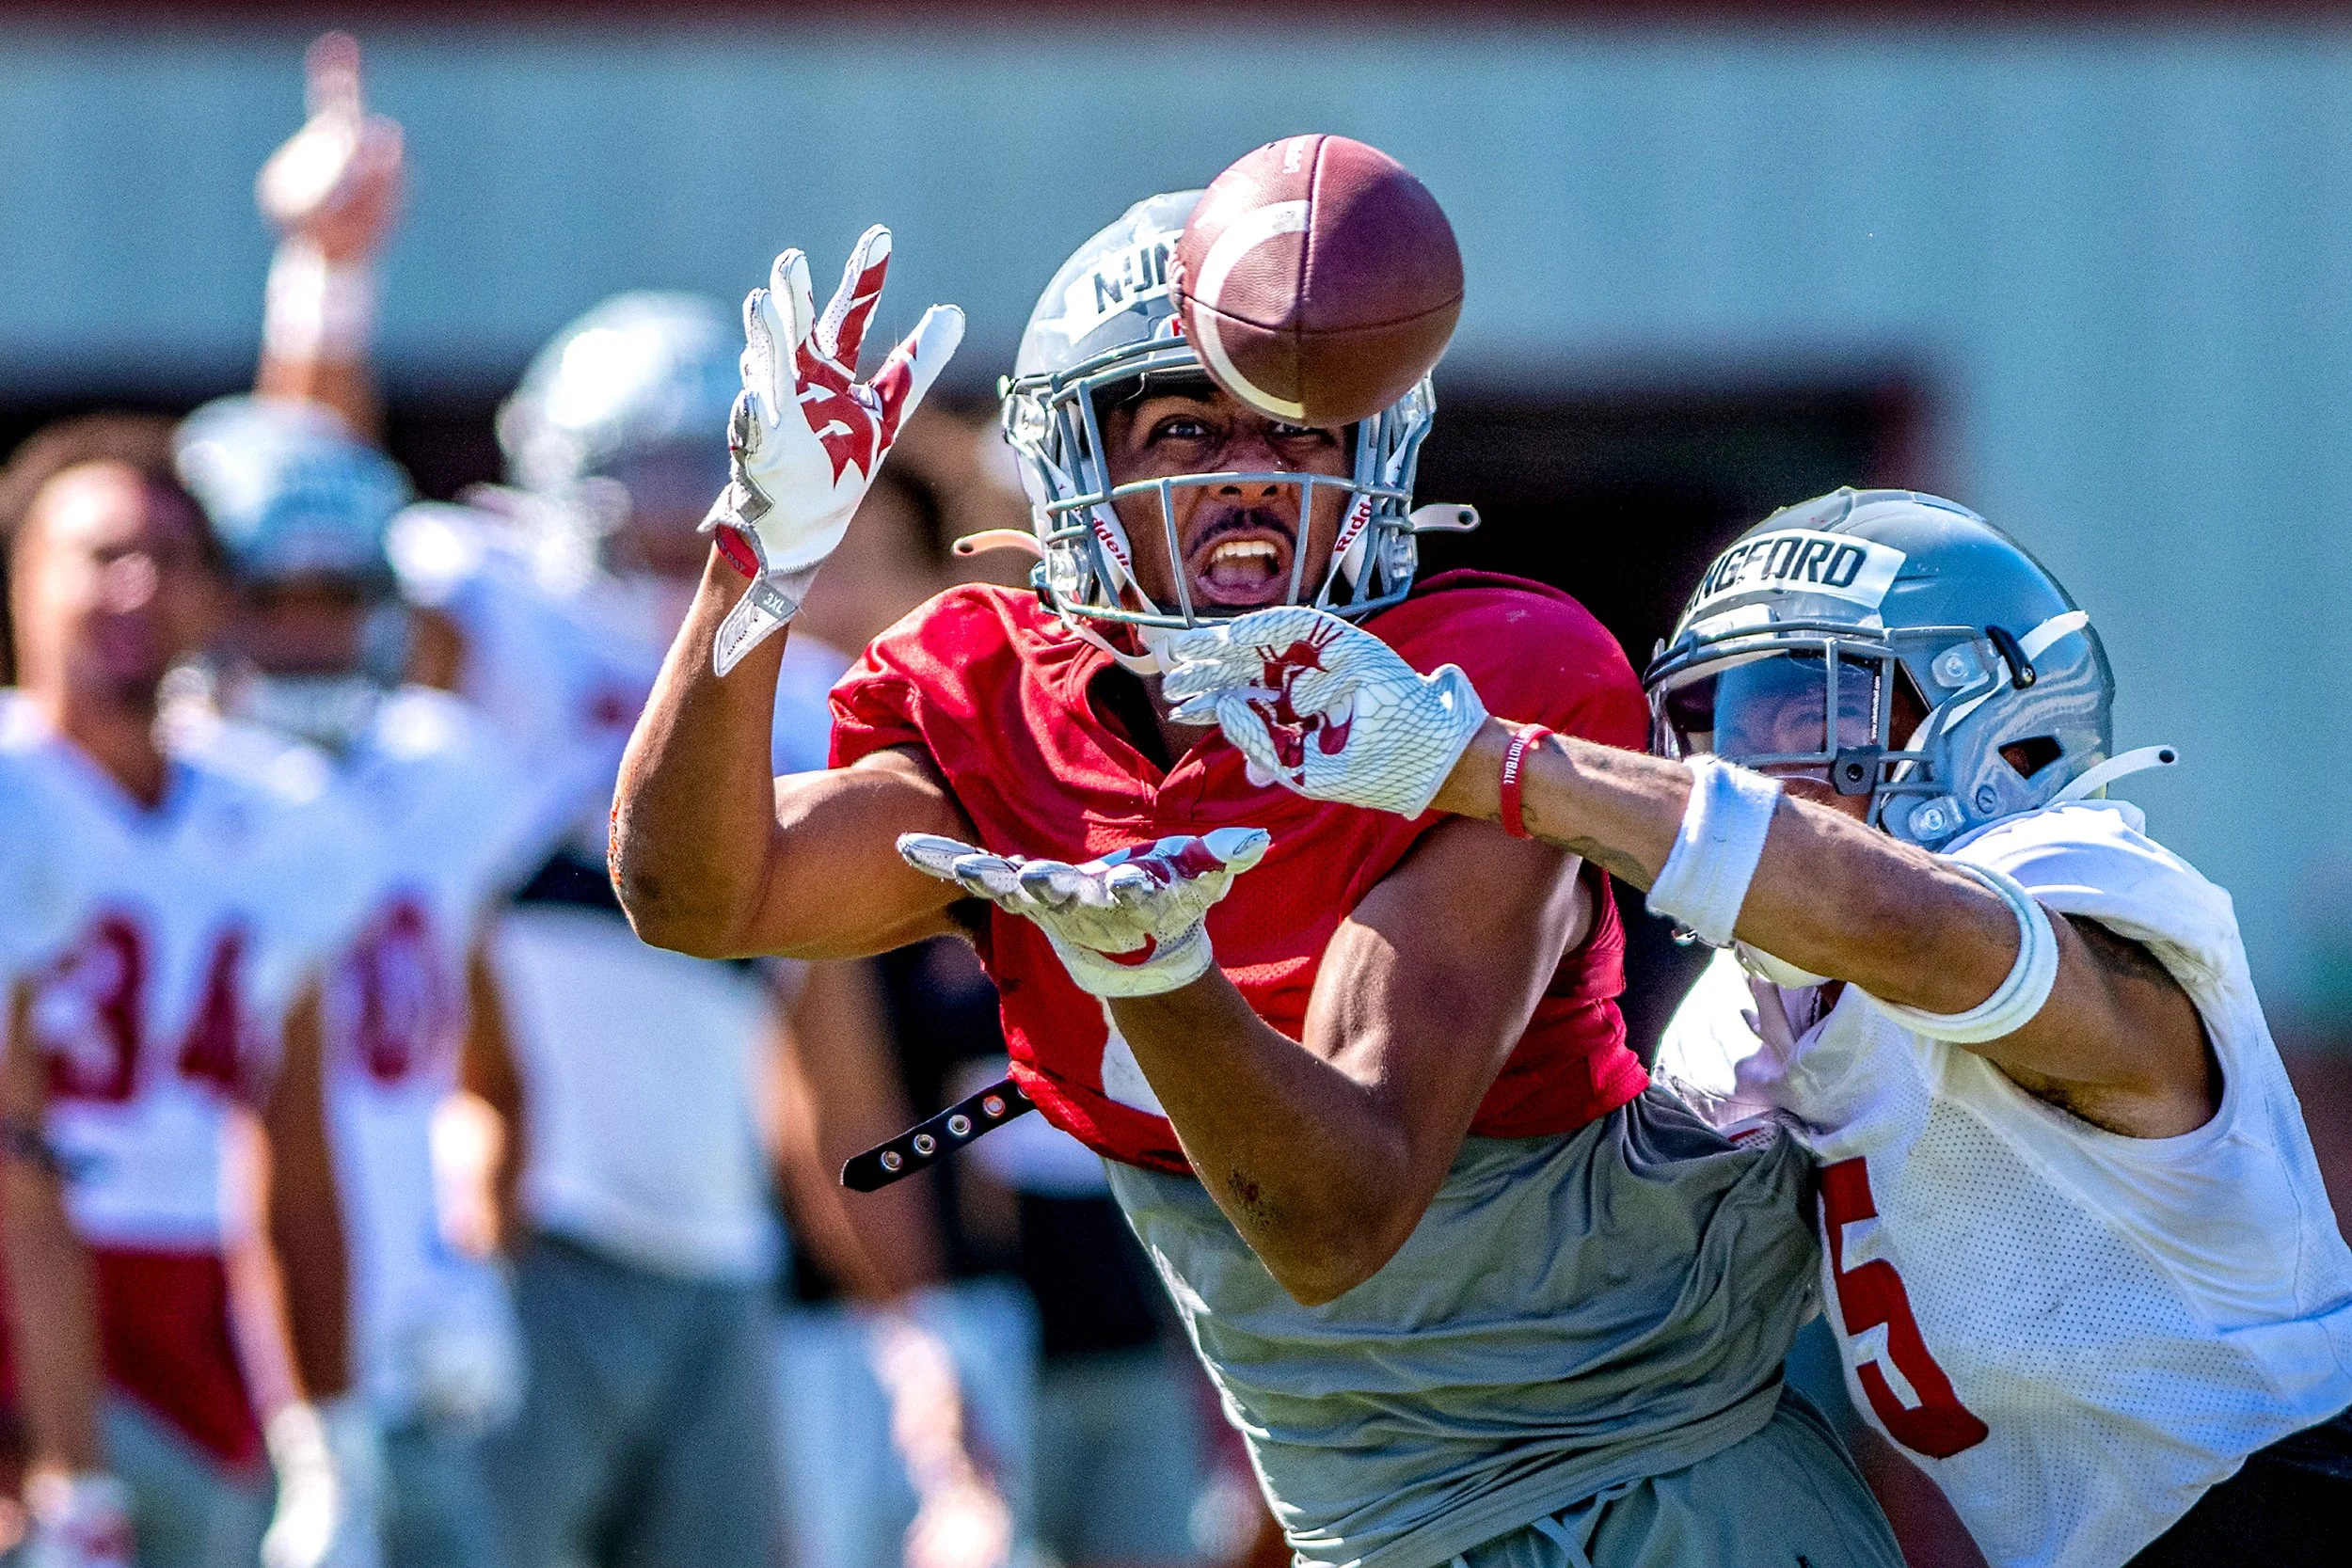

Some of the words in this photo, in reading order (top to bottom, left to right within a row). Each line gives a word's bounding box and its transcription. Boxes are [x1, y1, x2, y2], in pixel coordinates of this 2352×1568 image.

[763, 592, 786, 614] 3XL
[1693, 536, 1867, 607] NGFORD
[1820, 1155, 1990, 1461] 5
